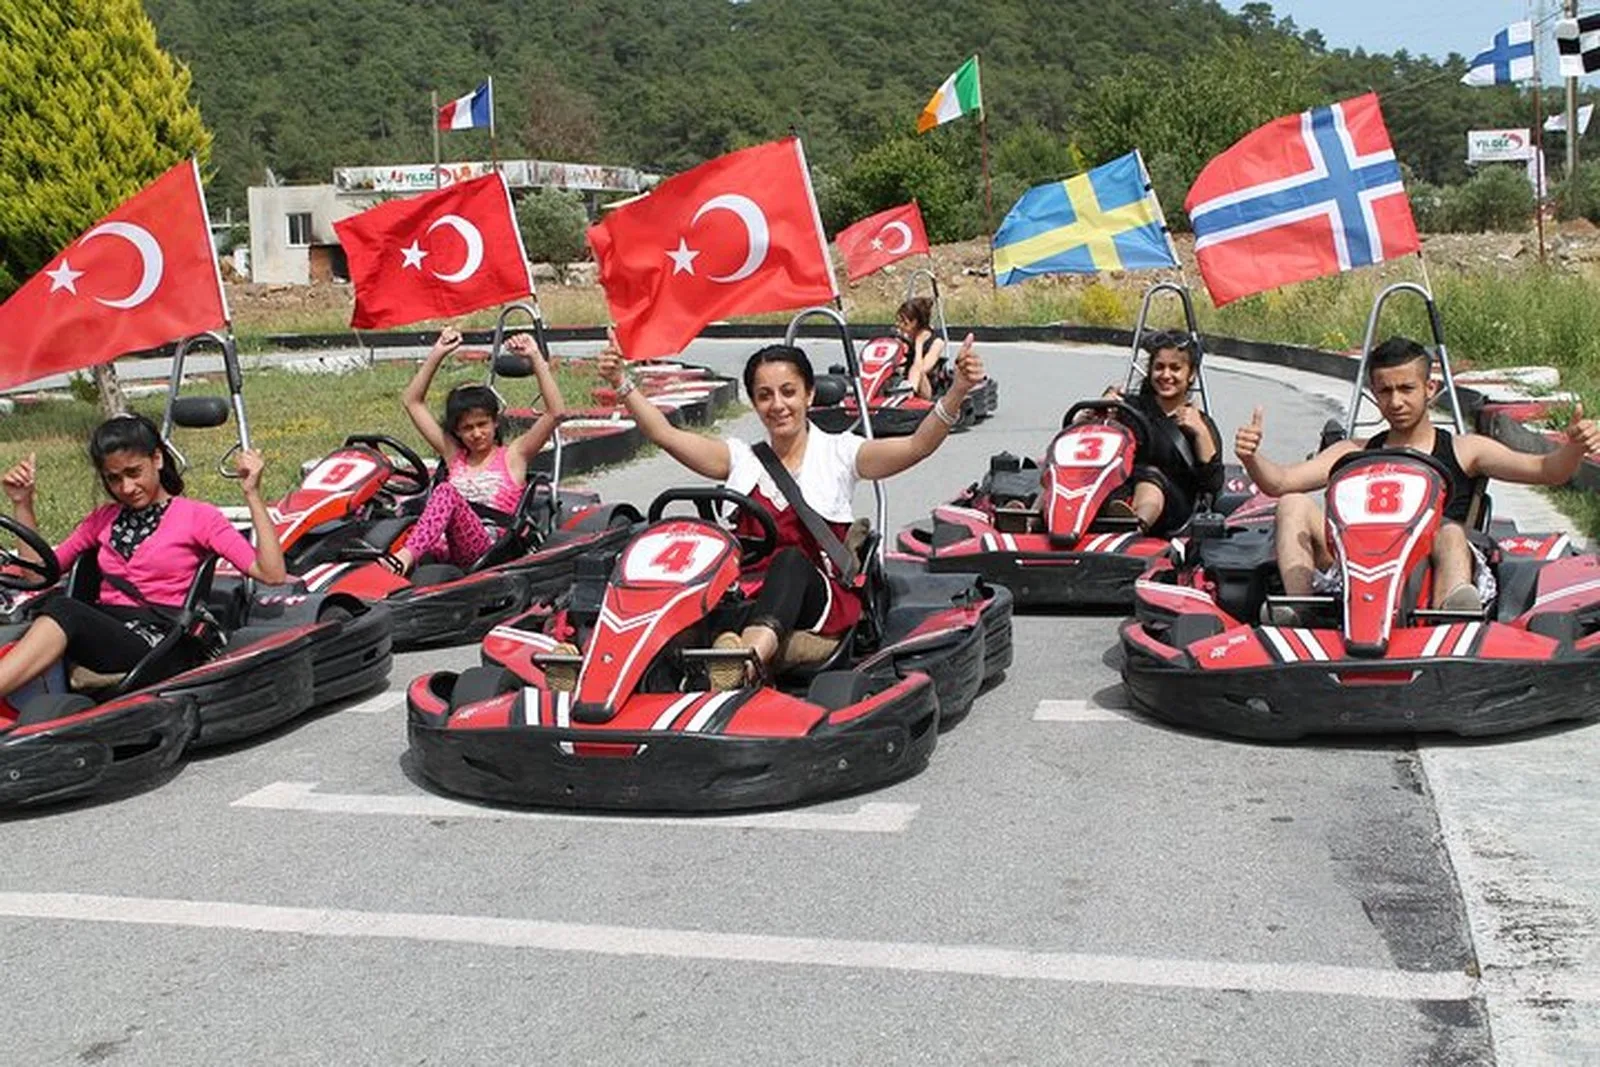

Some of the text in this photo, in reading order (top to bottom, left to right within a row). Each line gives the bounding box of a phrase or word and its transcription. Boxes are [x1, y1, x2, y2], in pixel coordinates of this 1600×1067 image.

[874, 346, 888, 358] 6
[1074, 437, 1104, 460] 3
[321, 463, 357, 485] 9
[1366, 480, 1405, 515] 8
[649, 539, 701, 573] 4
